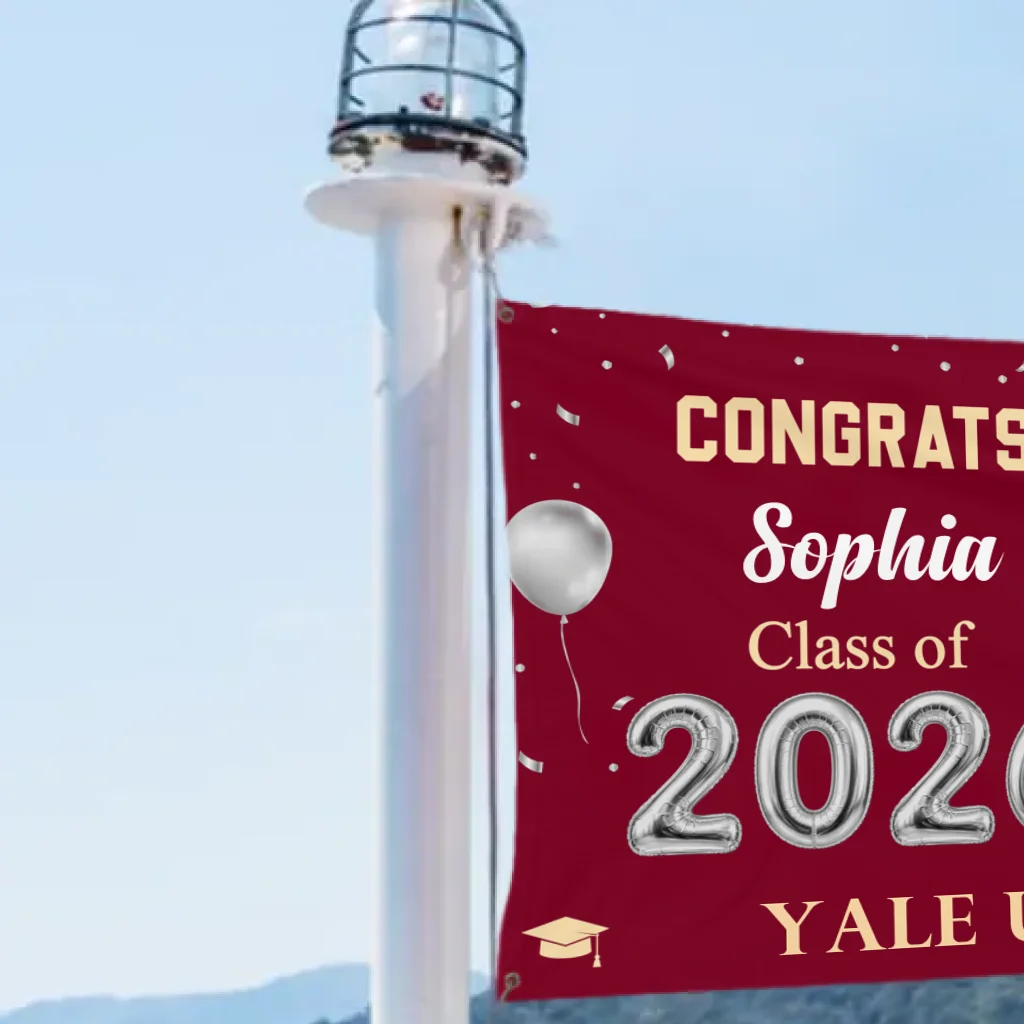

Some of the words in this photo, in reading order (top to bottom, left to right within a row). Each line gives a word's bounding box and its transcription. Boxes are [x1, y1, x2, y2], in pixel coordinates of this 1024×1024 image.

[742, 502, 1004, 610] Sophia
[748, 620, 896, 672] Class
[914, 619, 976, 671] of
[760, 893, 977, 957] YALE
